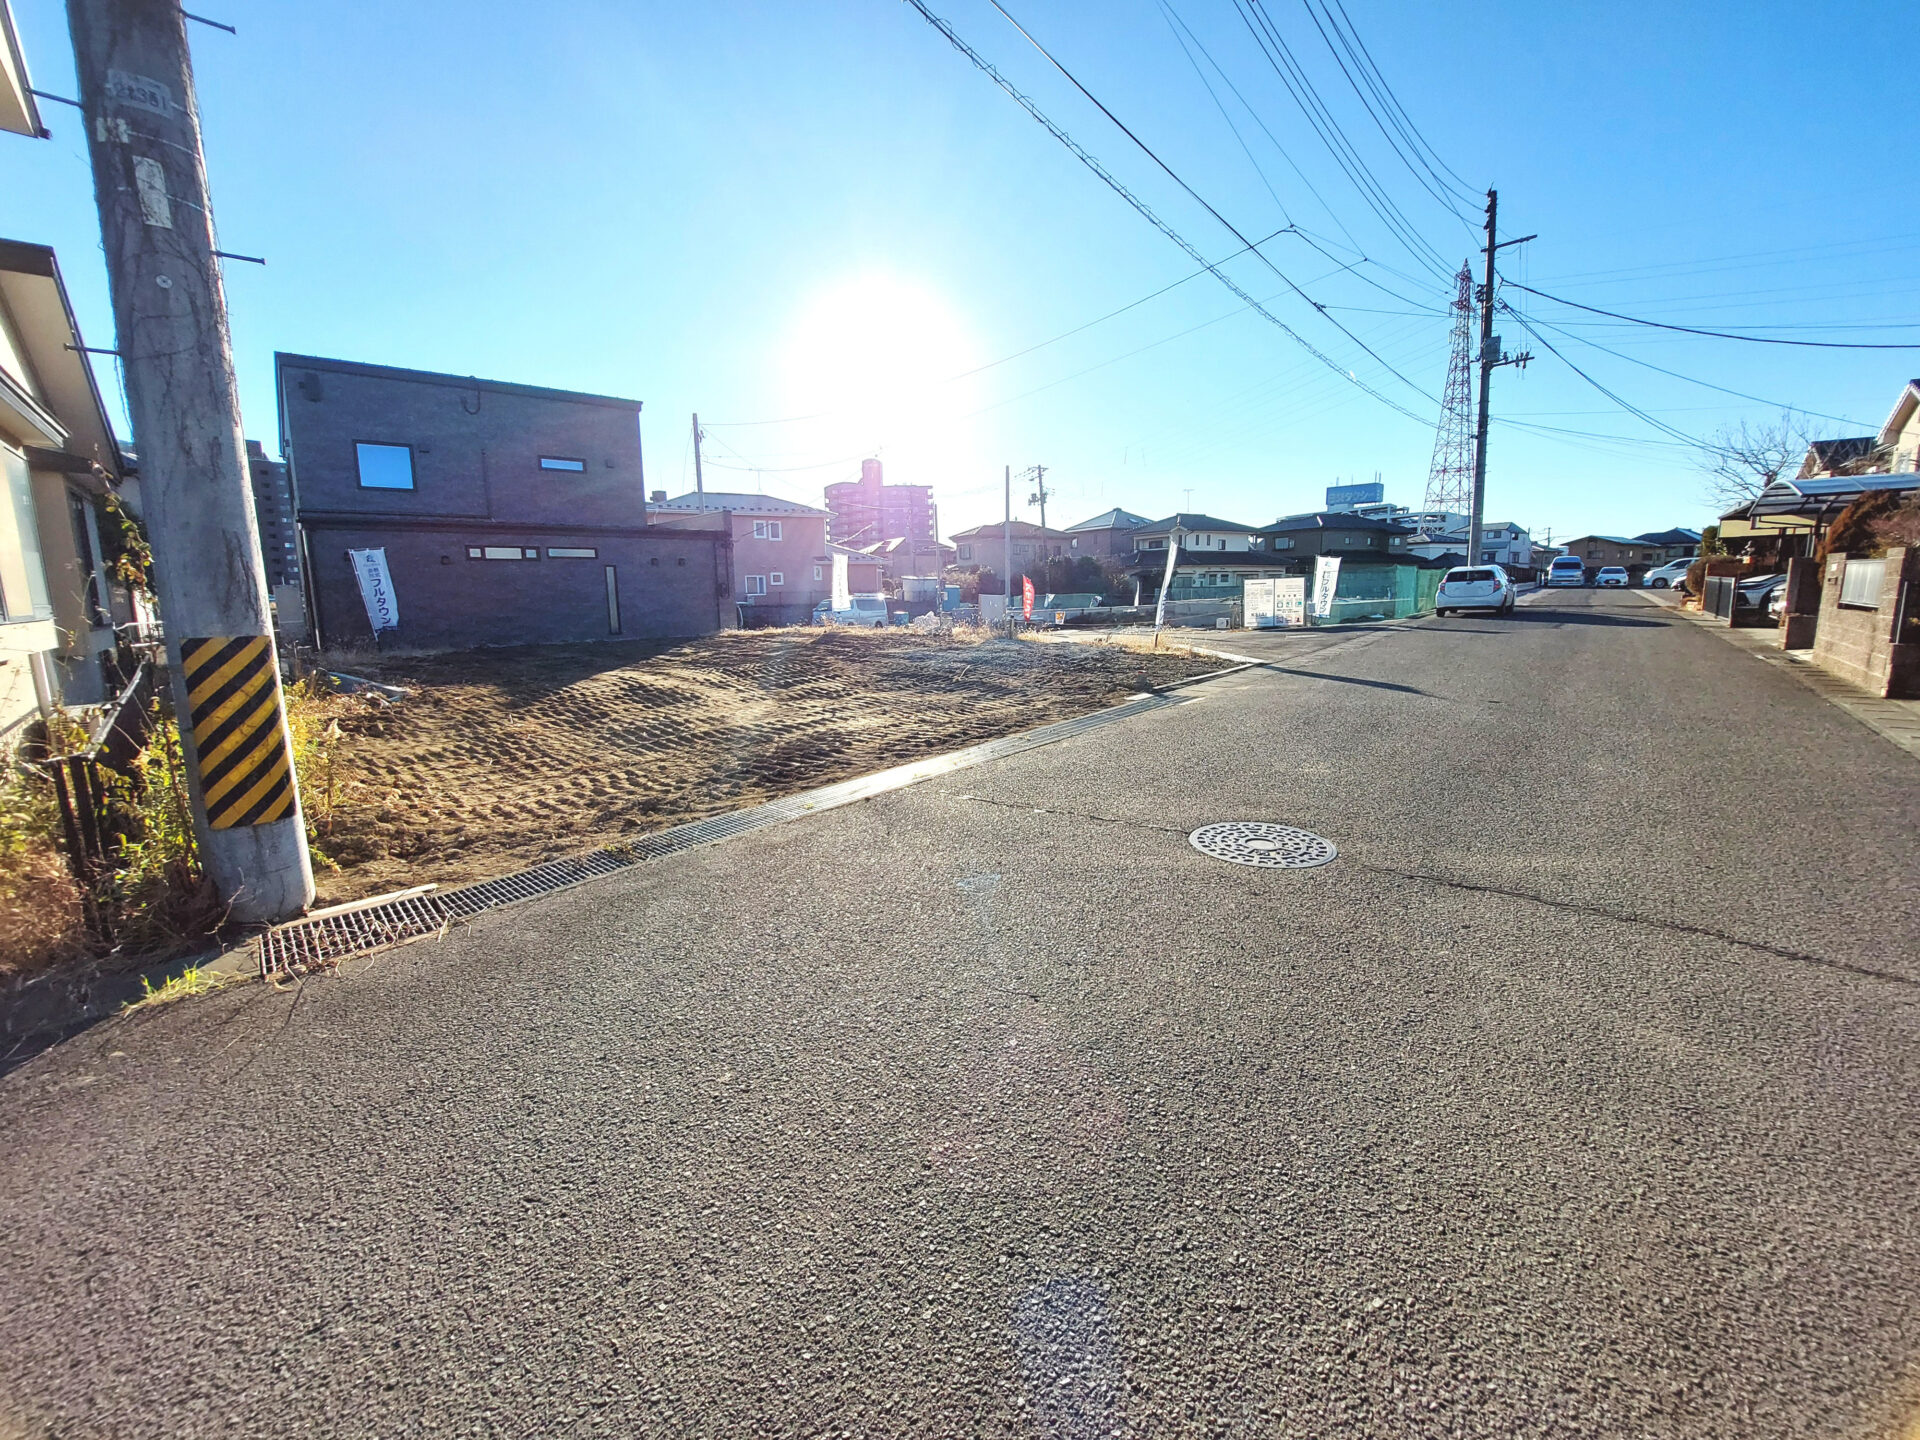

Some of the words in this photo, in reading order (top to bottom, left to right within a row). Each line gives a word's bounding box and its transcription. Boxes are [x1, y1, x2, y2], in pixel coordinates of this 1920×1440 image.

[370, 578, 391, 625] フルタウン
